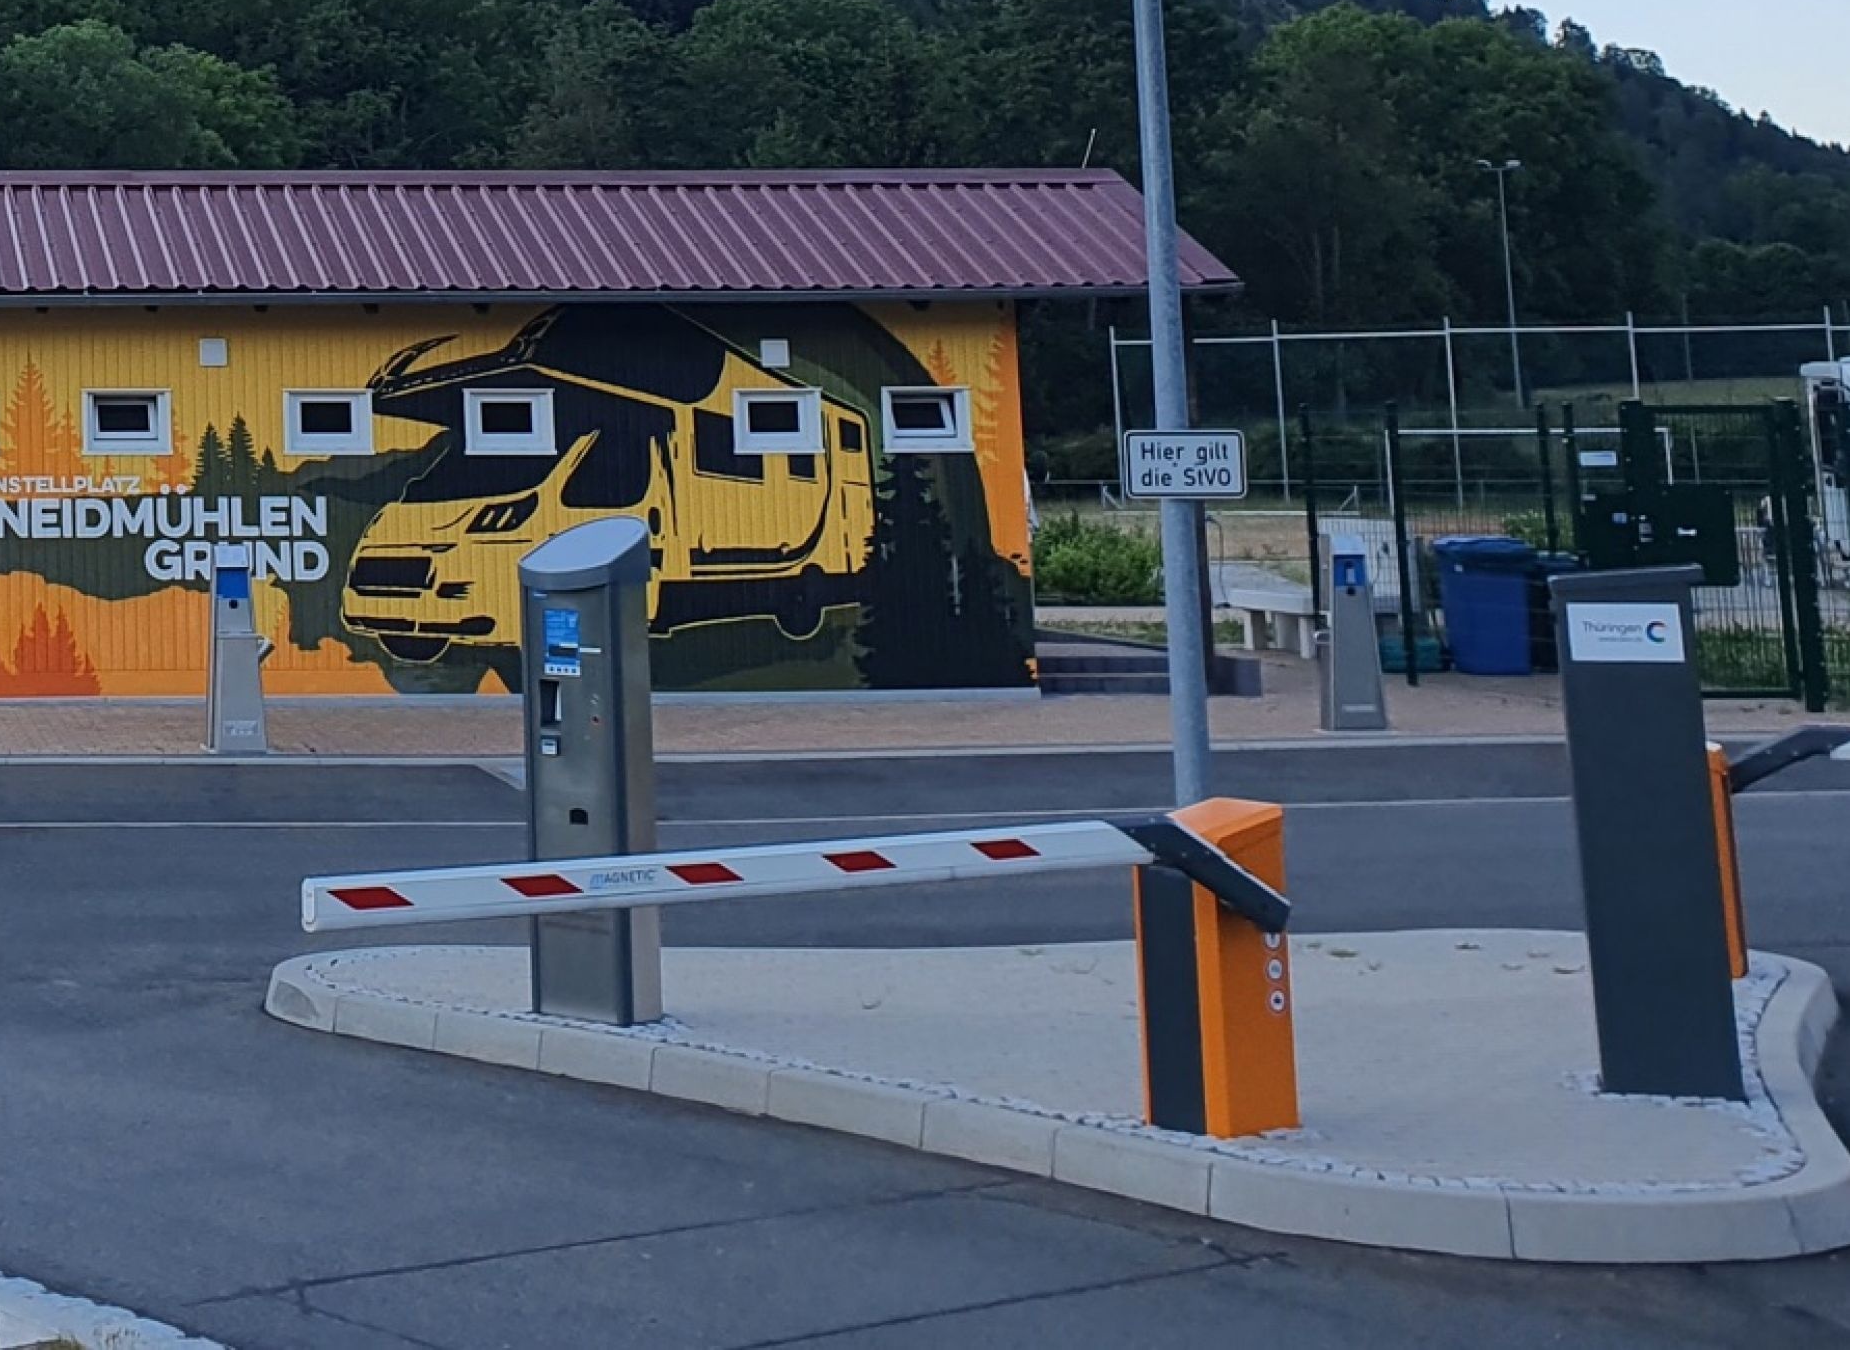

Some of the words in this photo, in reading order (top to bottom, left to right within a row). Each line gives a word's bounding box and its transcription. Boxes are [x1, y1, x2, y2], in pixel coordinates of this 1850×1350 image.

[1140, 441, 1185, 460] Hier
[1195, 441, 1229, 466] gilt
[1141, 467, 1173, 487] die
[1183, 467, 1232, 487] StVO
[143, 539, 330, 582] GRND
